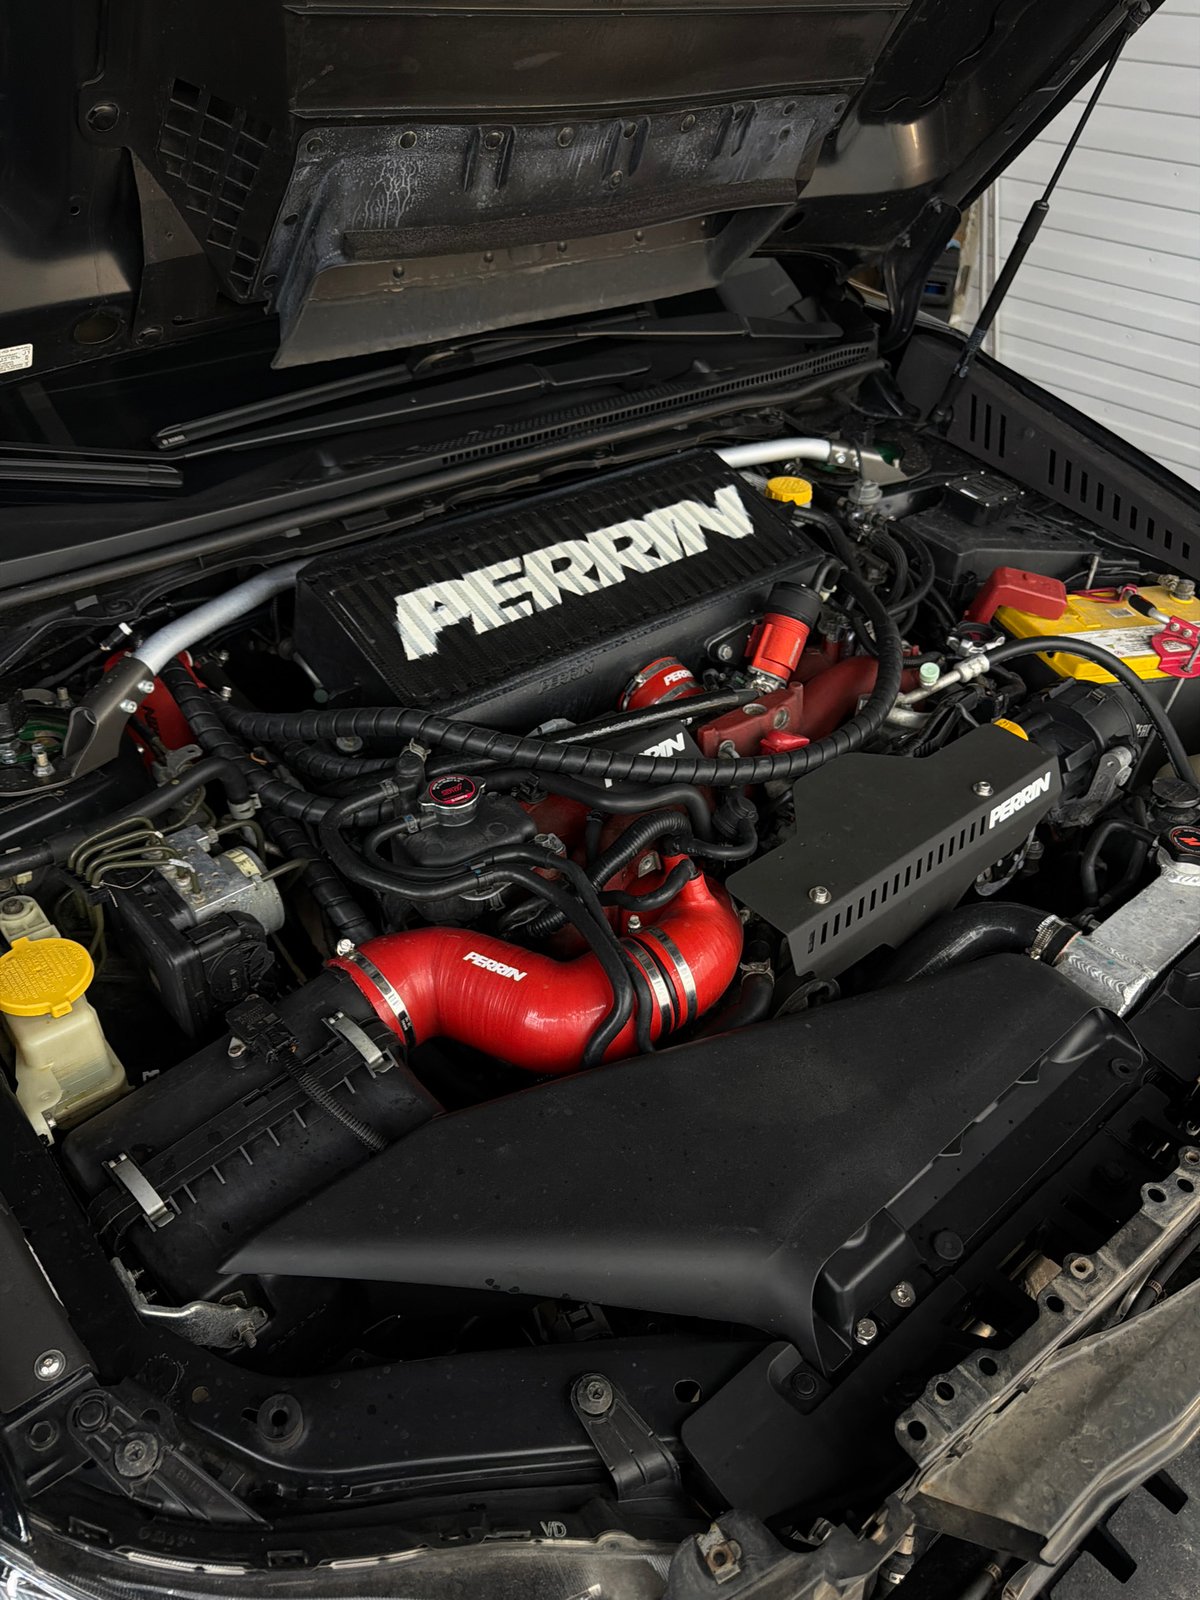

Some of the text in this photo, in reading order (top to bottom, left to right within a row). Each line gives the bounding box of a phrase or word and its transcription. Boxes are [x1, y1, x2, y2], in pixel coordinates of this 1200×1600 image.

[394, 485, 754, 660] PERRIN
[988, 771, 1051, 830] PERRIN
[462, 951, 528, 982] PERRIN
[540, 1521, 567, 1538] VD
